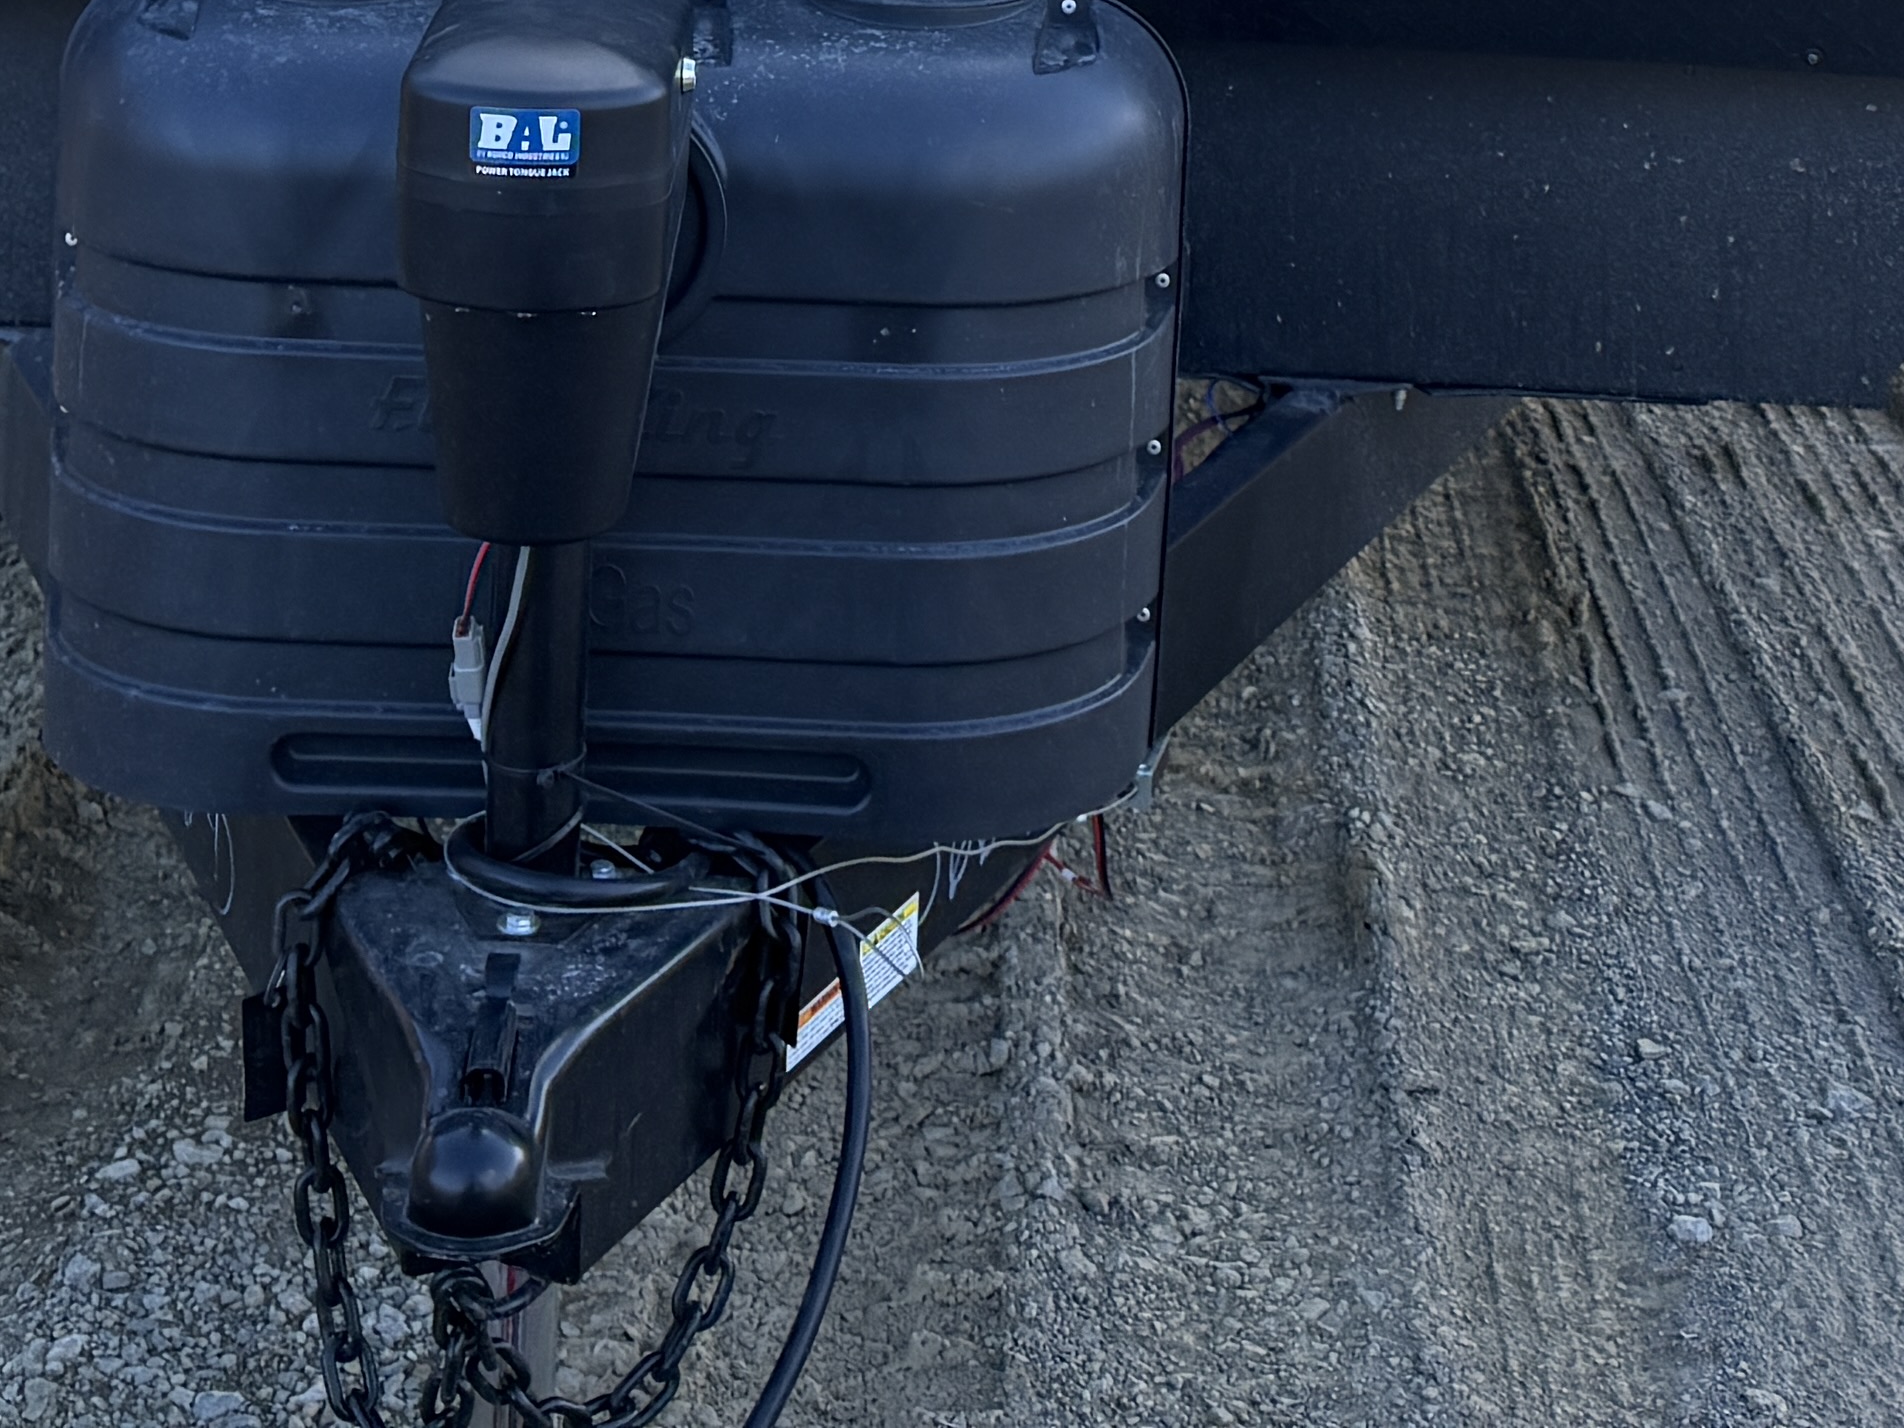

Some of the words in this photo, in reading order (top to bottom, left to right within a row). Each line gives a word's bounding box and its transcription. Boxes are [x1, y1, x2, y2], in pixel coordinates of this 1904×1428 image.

[477, 113, 572, 151] BAL
[476, 165, 508, 176] POWER
[509, 167, 546, 177] TONGUE
[547, 167, 570, 177] JACK
